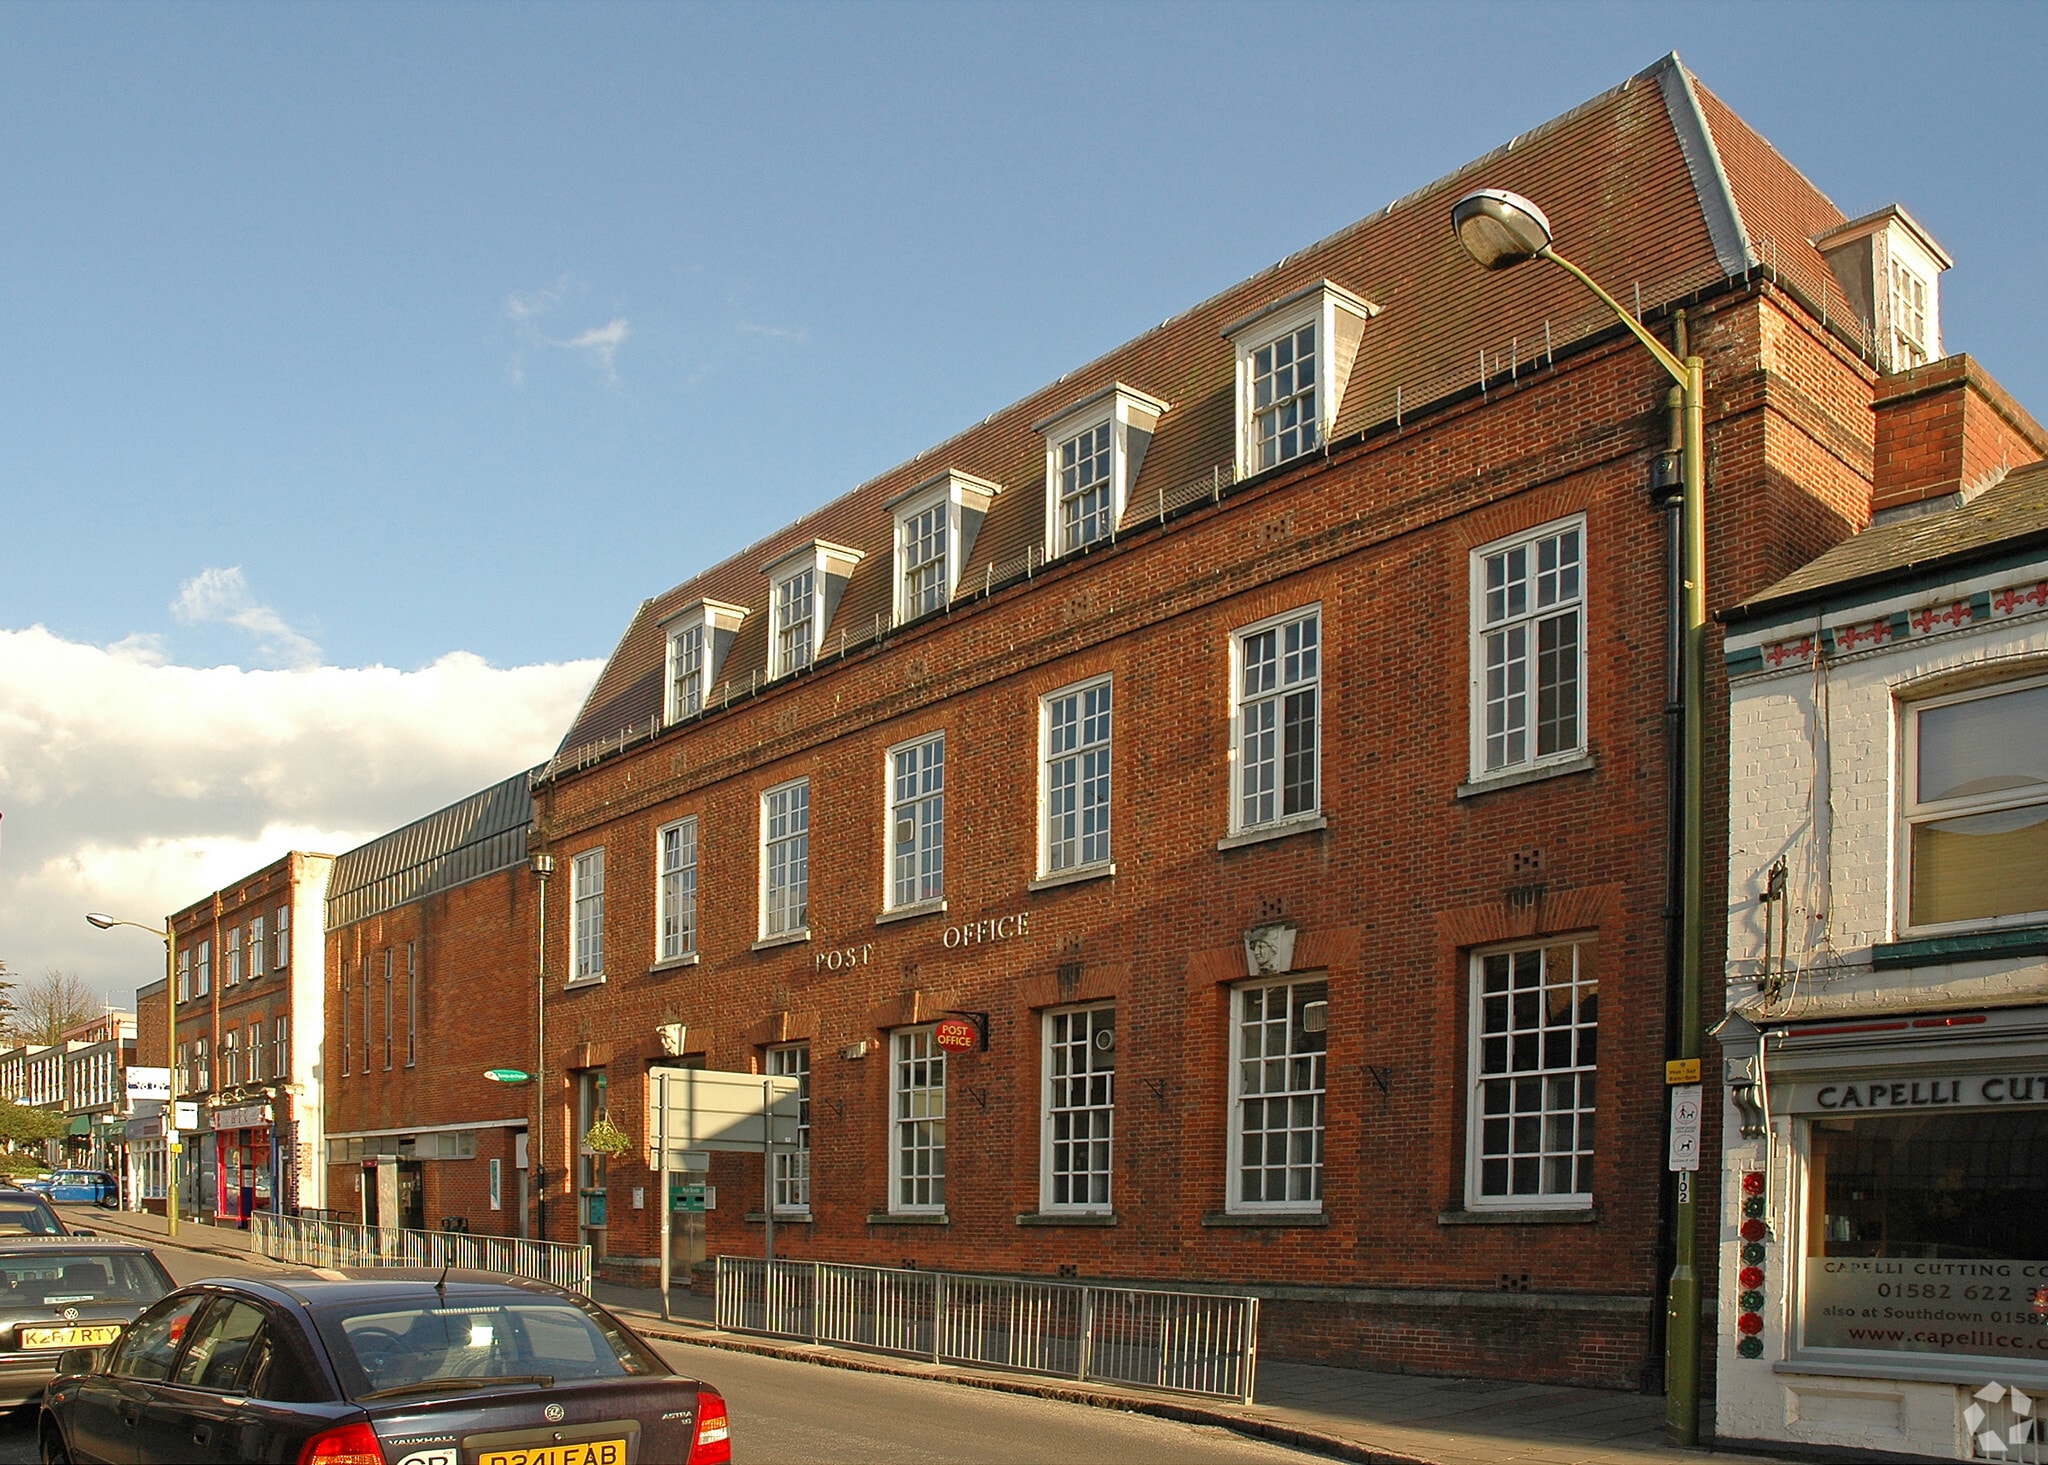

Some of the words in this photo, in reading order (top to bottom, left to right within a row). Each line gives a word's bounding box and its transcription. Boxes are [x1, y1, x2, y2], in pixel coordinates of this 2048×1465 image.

[816, 943, 873, 973] POST
[943, 912, 1029, 949] OFFICE
[942, 1025, 969, 1035] POST
[937, 1034, 972, 1047] OFFICE
[1817, 1080, 1961, 1108] CAPELLI
[1824, 1262, 1903, 1274] CAPELLI
[1914, 1264, 2011, 1277] CUTTING
[1877, 1283, 1952, 1299] 01582
[1964, 1286, 2012, 1302] 622
[1822, 1305, 1855, 1317] also
[1862, 1307, 1878, 1318] at
[1883, 1306, 1983, 1322] Southdown
[661, 1411, 692, 1420] ASTRA
[388, 1435, 456, 1446] VAUXHALL
